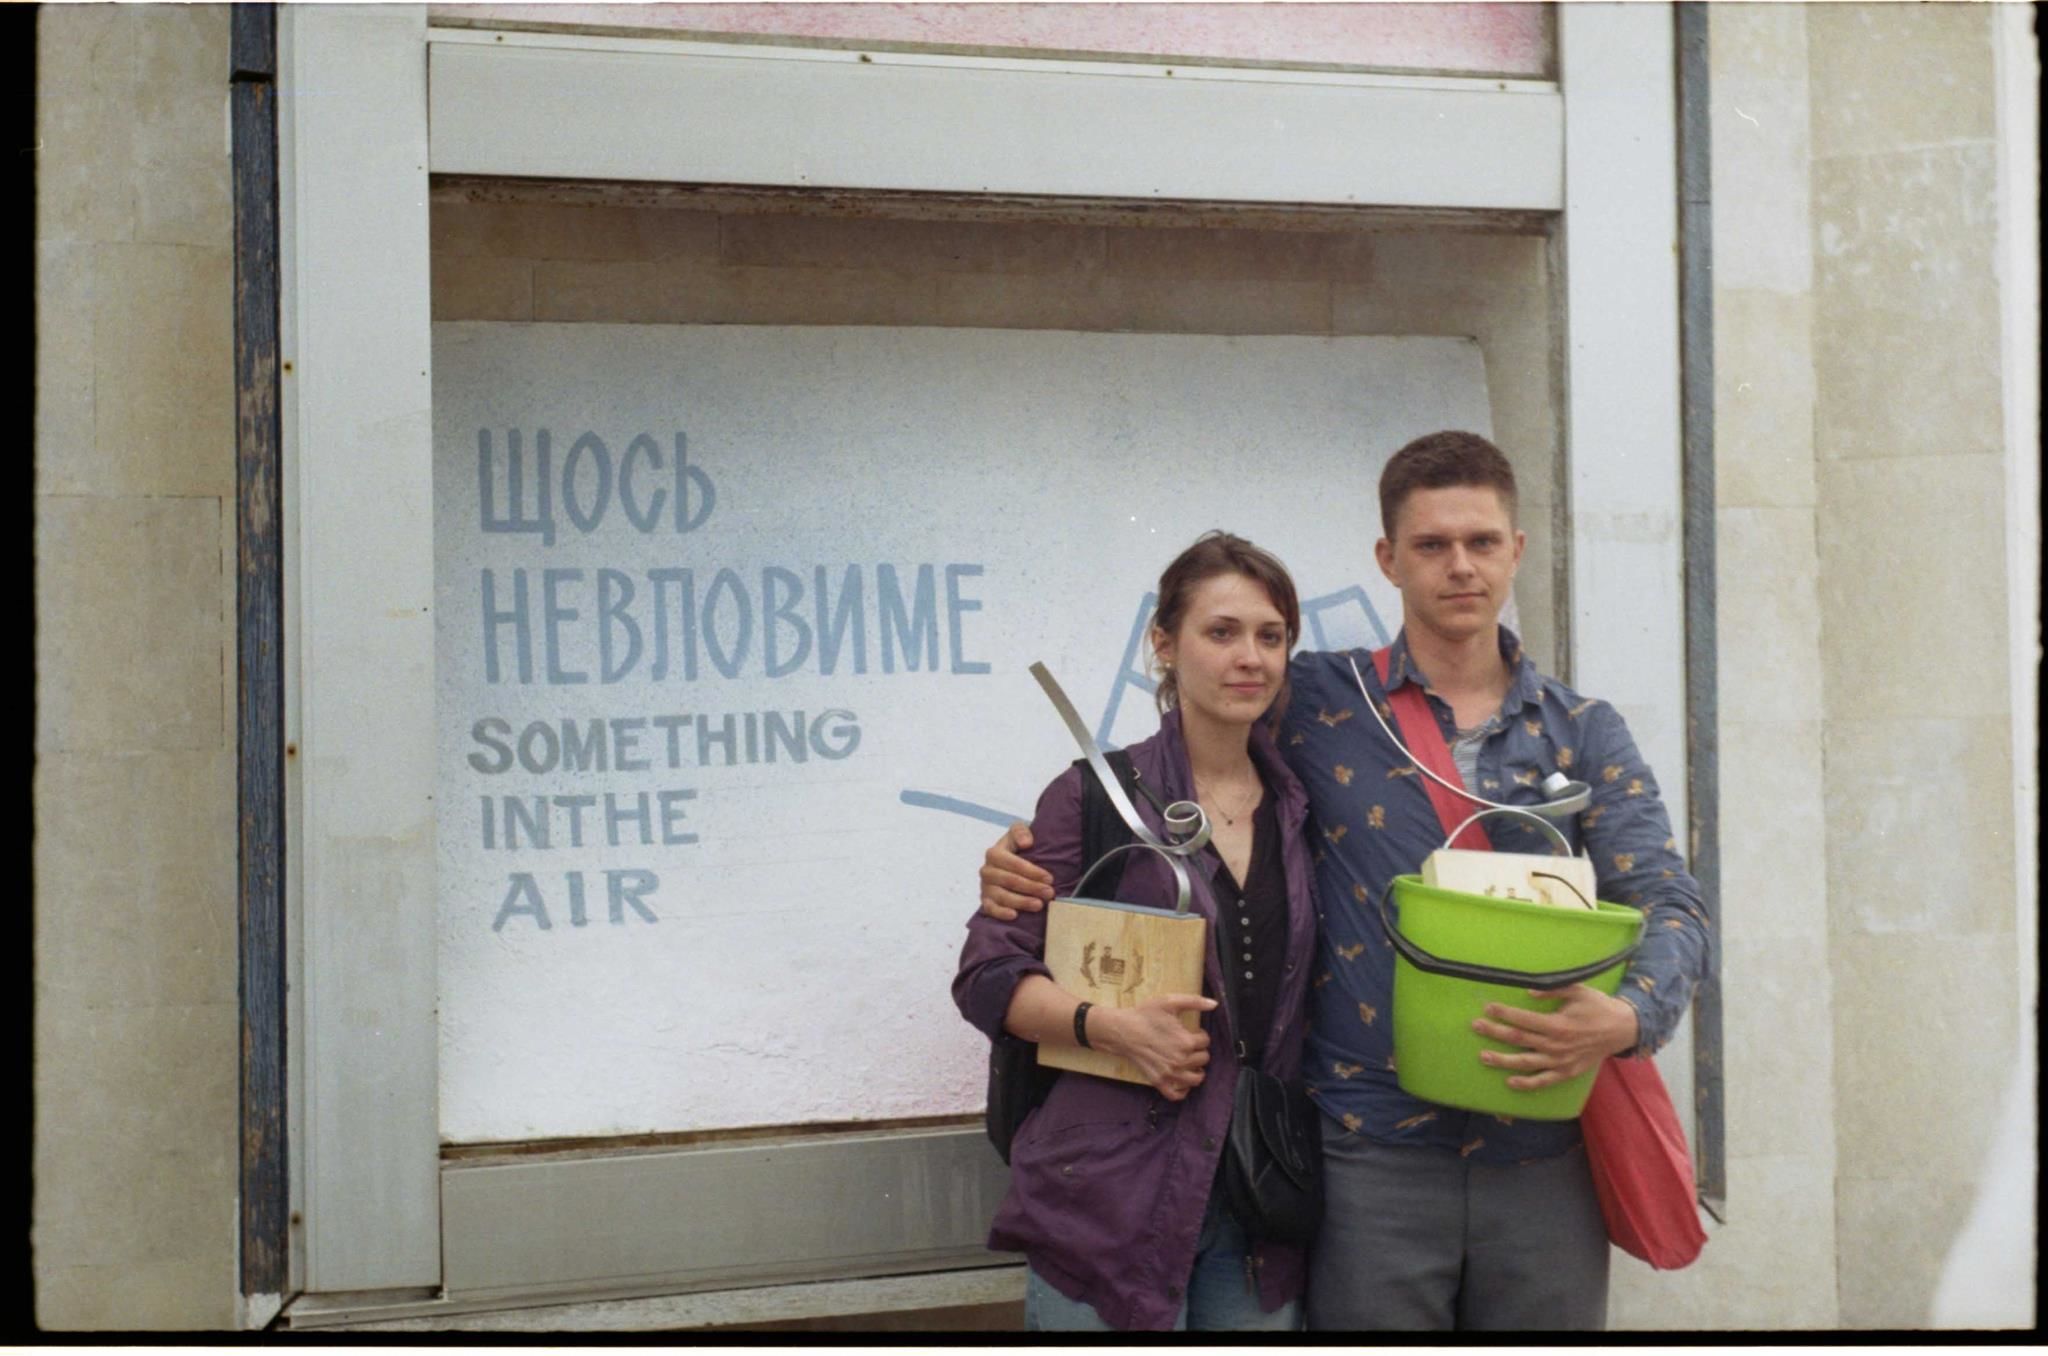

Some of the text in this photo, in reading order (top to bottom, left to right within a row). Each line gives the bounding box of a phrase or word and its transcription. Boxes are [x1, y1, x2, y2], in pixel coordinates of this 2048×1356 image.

[478, 428, 716, 546] ЩОСЬ
[481, 563, 992, 684] НЕВЛОВИМЕ
[467, 708, 862, 775] SOMETHING
[491, 867, 661, 932] AIR
